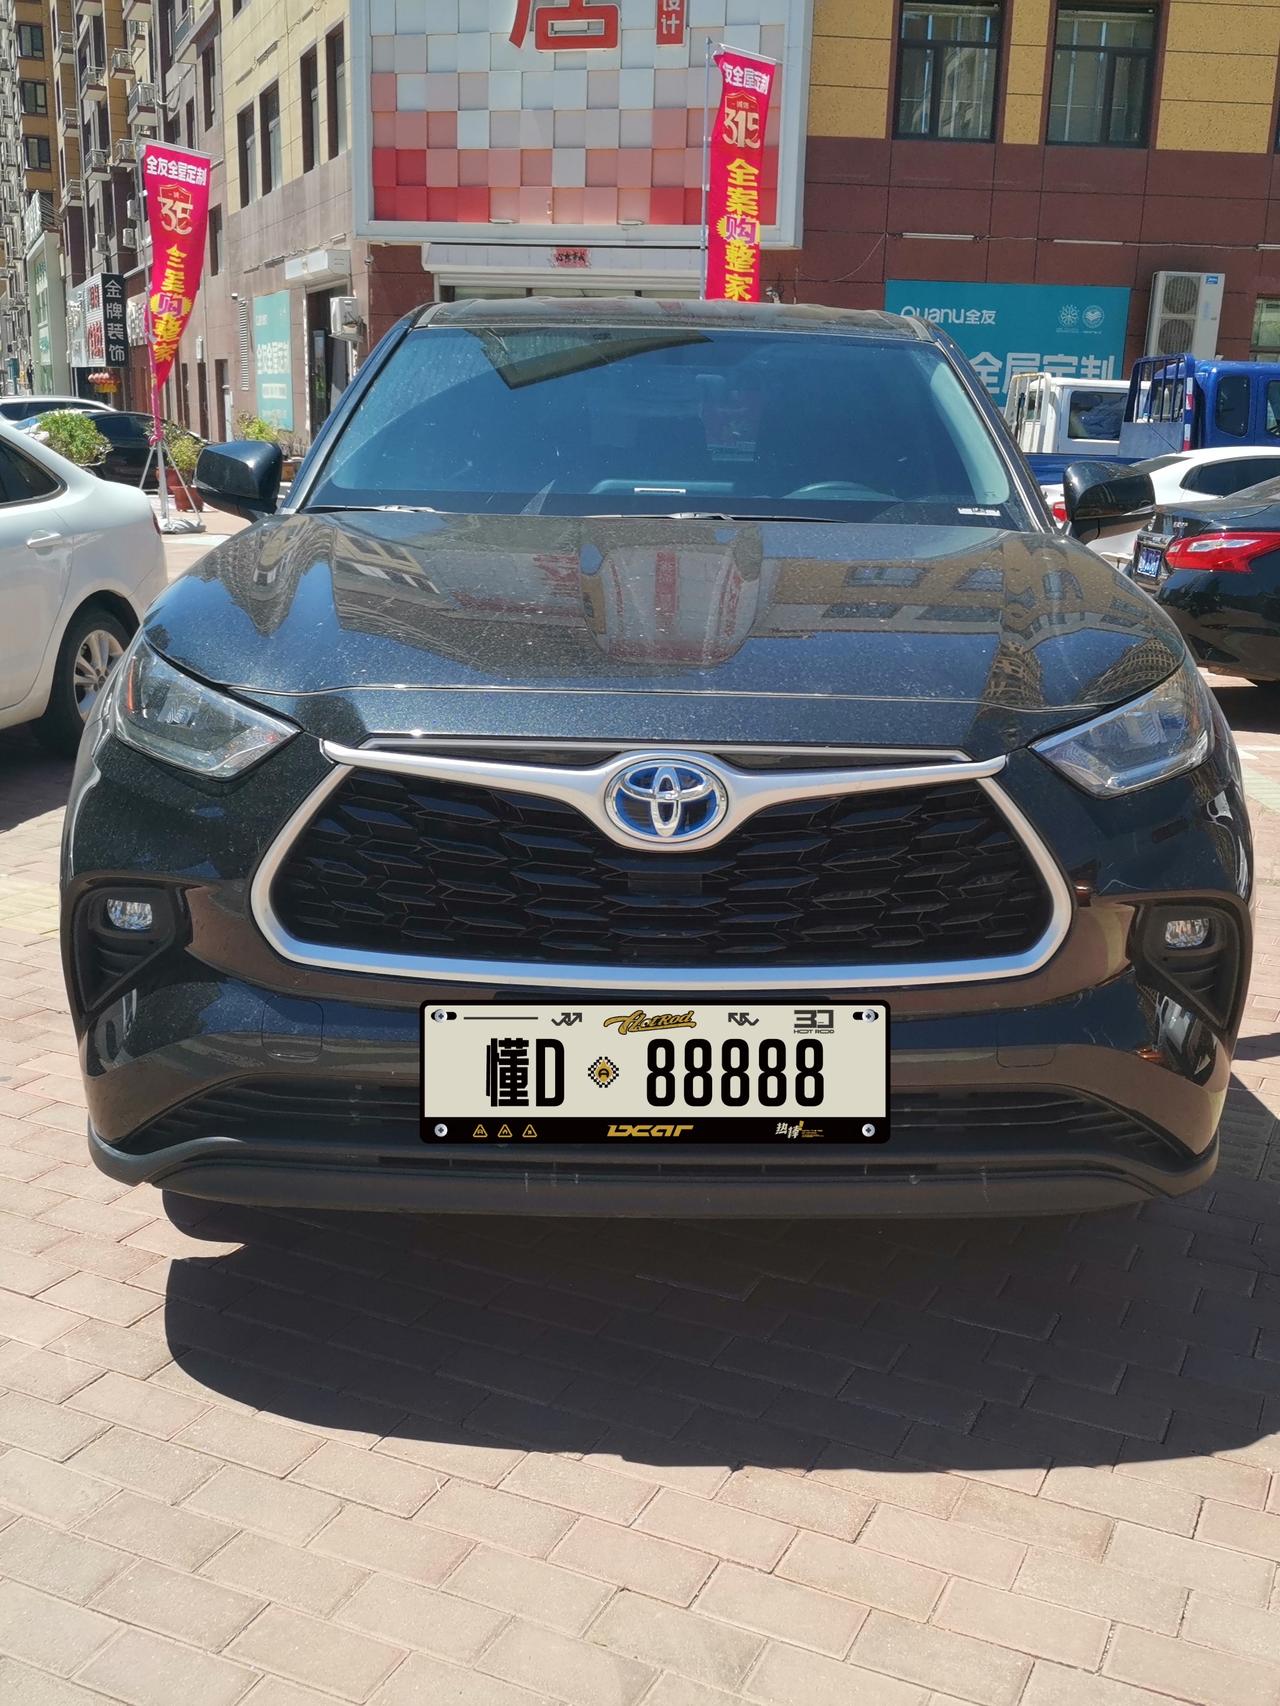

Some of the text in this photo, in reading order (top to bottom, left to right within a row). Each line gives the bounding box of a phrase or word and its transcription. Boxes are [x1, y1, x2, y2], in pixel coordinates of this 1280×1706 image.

[722, 107, 761, 148] 315
[105, 279, 125, 362] 金牌装饰
[965, 309, 996, 325] 全友
